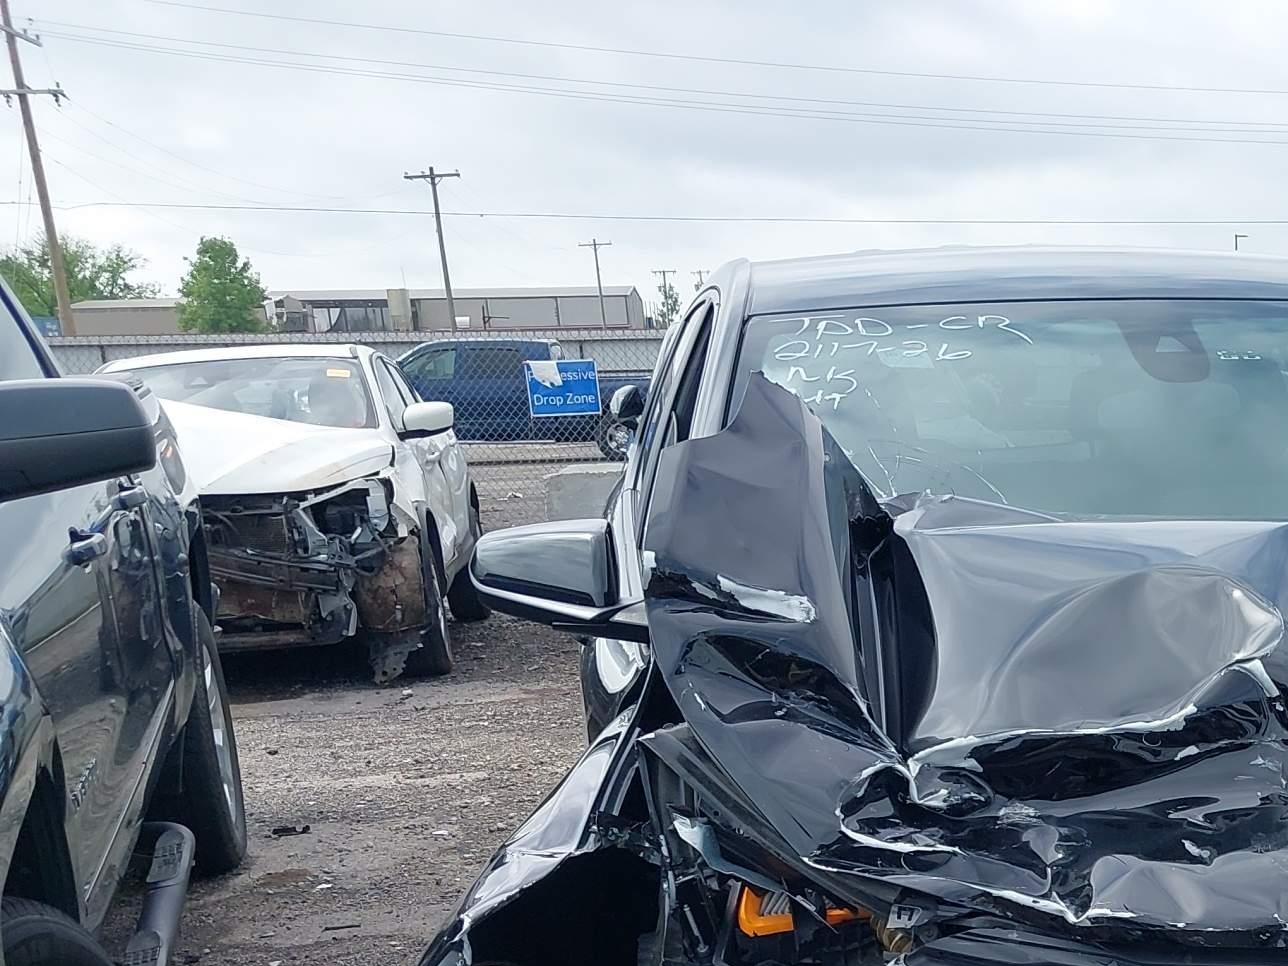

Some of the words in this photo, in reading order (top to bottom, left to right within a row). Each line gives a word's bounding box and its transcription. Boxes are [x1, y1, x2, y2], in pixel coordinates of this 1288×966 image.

[528, 369, 596, 382] Pessive
[534, 394, 564, 408] Drop
[566, 393, 596, 405] Zone
